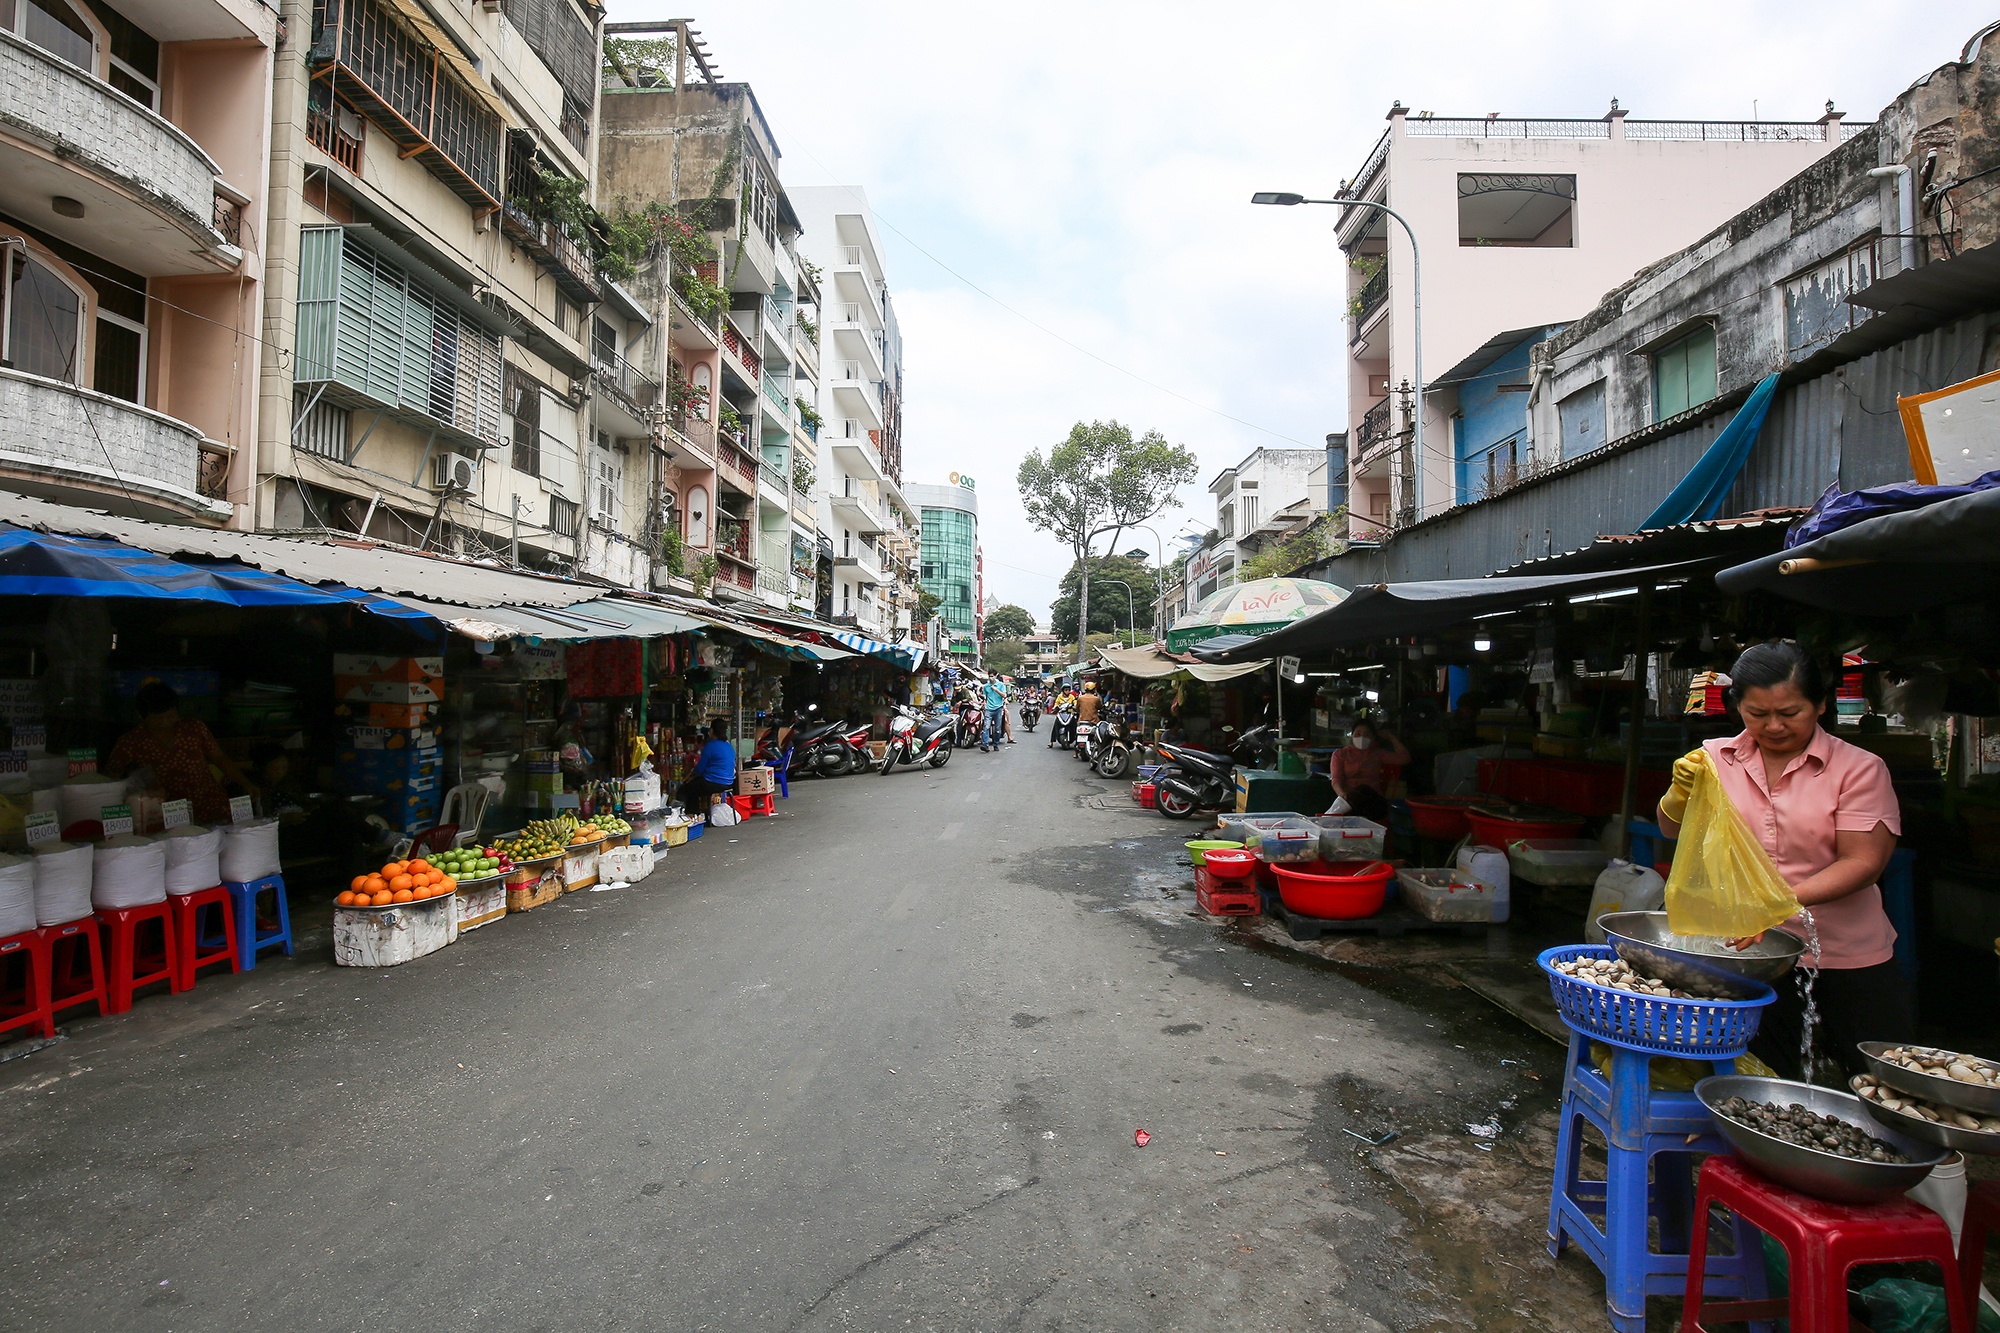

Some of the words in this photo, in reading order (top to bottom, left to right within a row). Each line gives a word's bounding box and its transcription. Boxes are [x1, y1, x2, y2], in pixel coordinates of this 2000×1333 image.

[524, 647, 557, 659] ACTION
[346, 726, 392, 738] CITRUS
[14, 734, 45, 748] 21000
[105, 818, 132, 833] 18000
[165, 812, 189, 826] 17000
[28, 824, 60, 842] 18000
